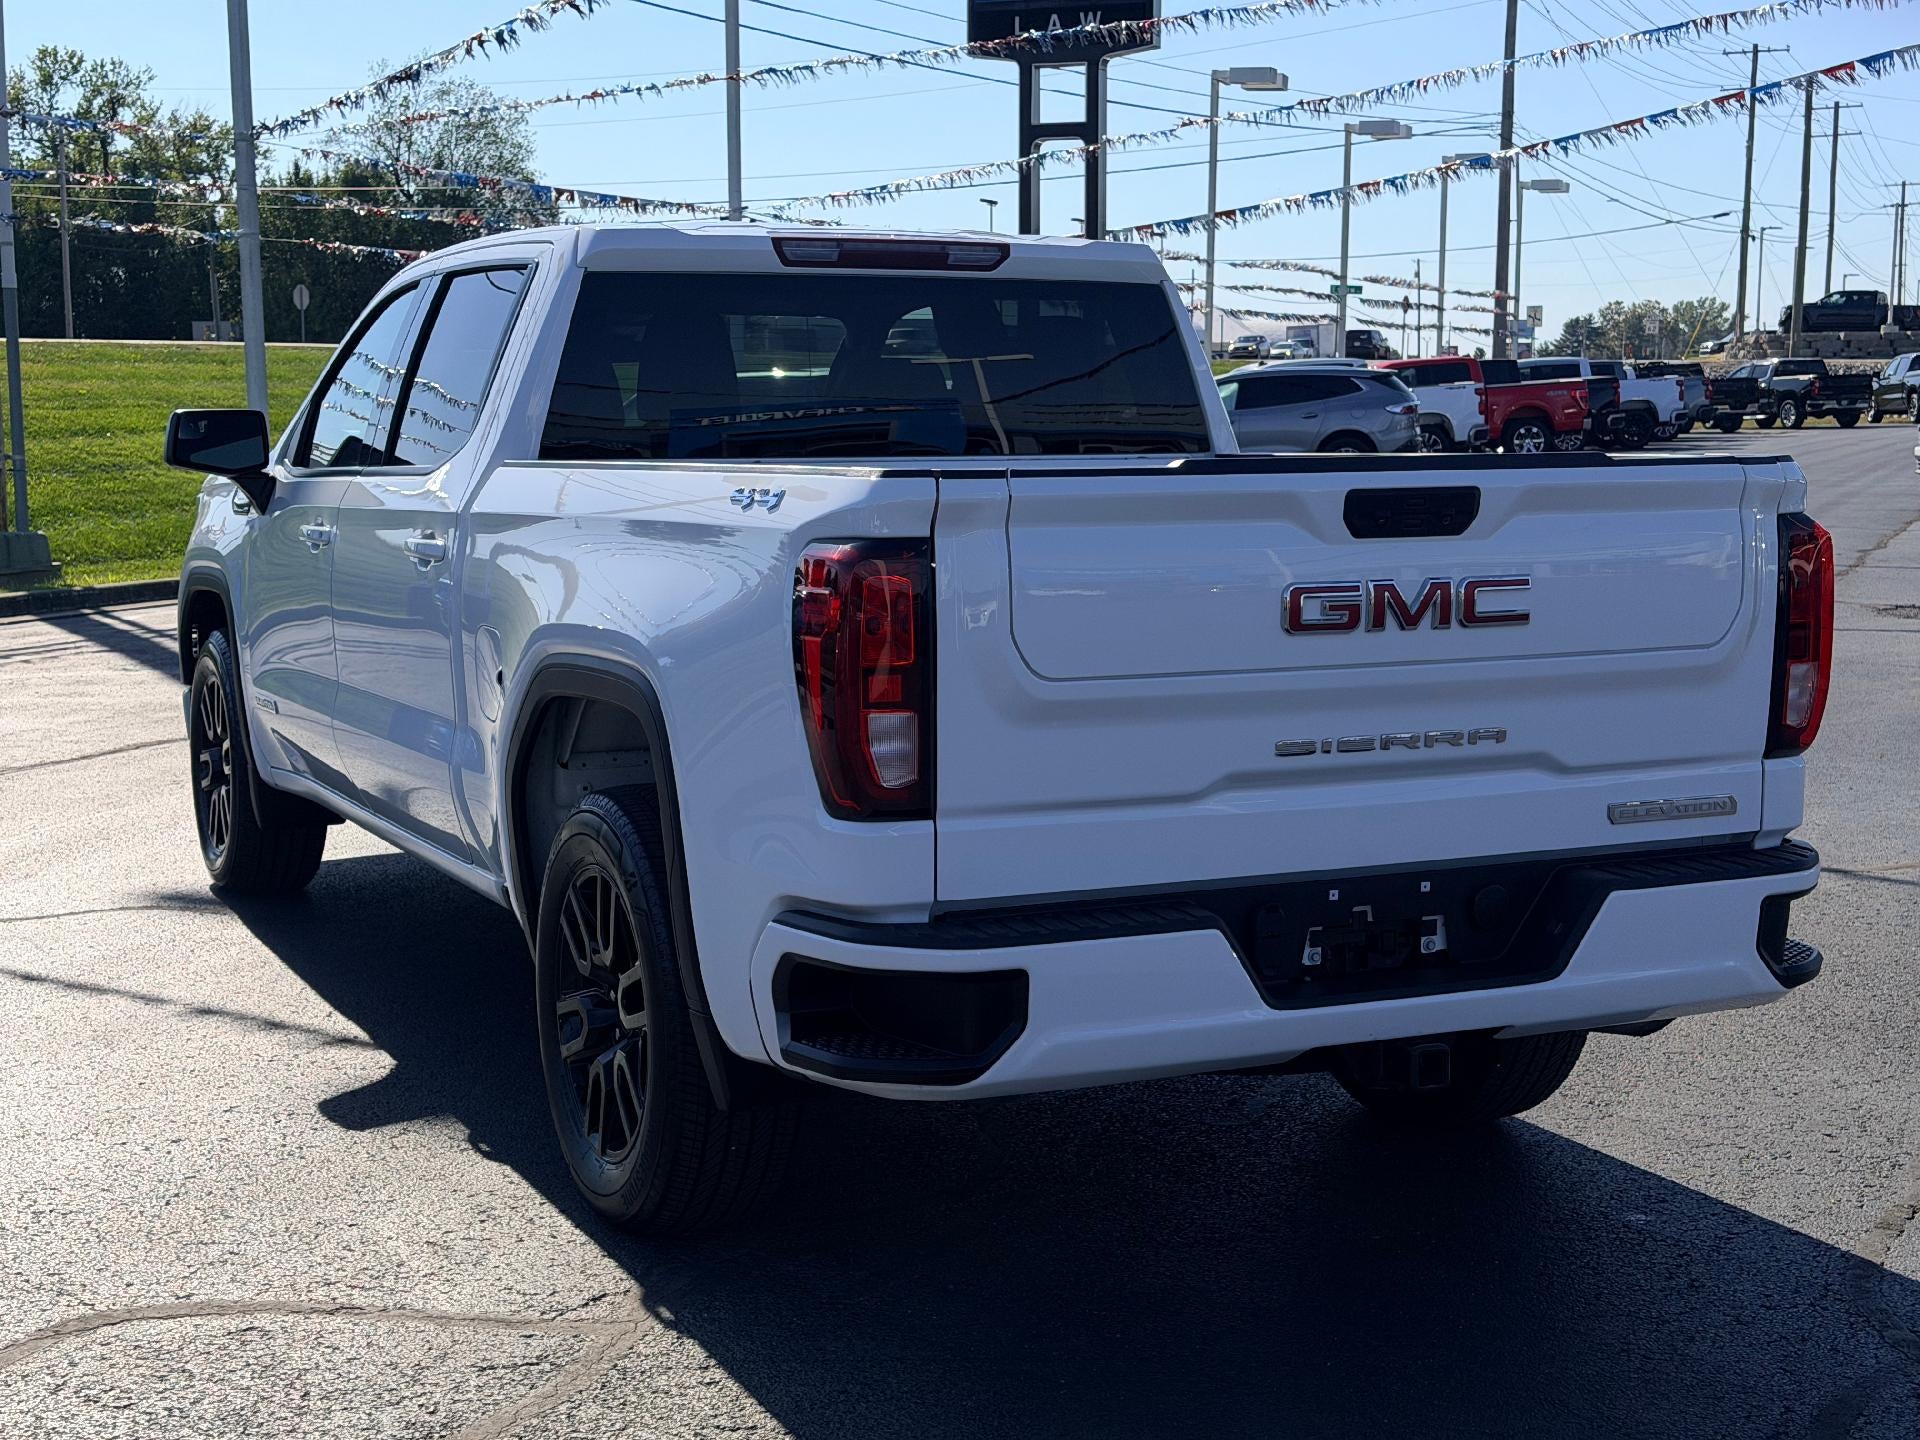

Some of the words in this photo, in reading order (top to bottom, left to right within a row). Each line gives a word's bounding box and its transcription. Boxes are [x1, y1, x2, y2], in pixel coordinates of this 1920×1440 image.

[1013, 11, 1102, 37] LAW
[1280, 574, 1532, 635] GMC
[1274, 727, 1507, 757] SIERRA
[1618, 799, 1729, 819] ELEVATION
